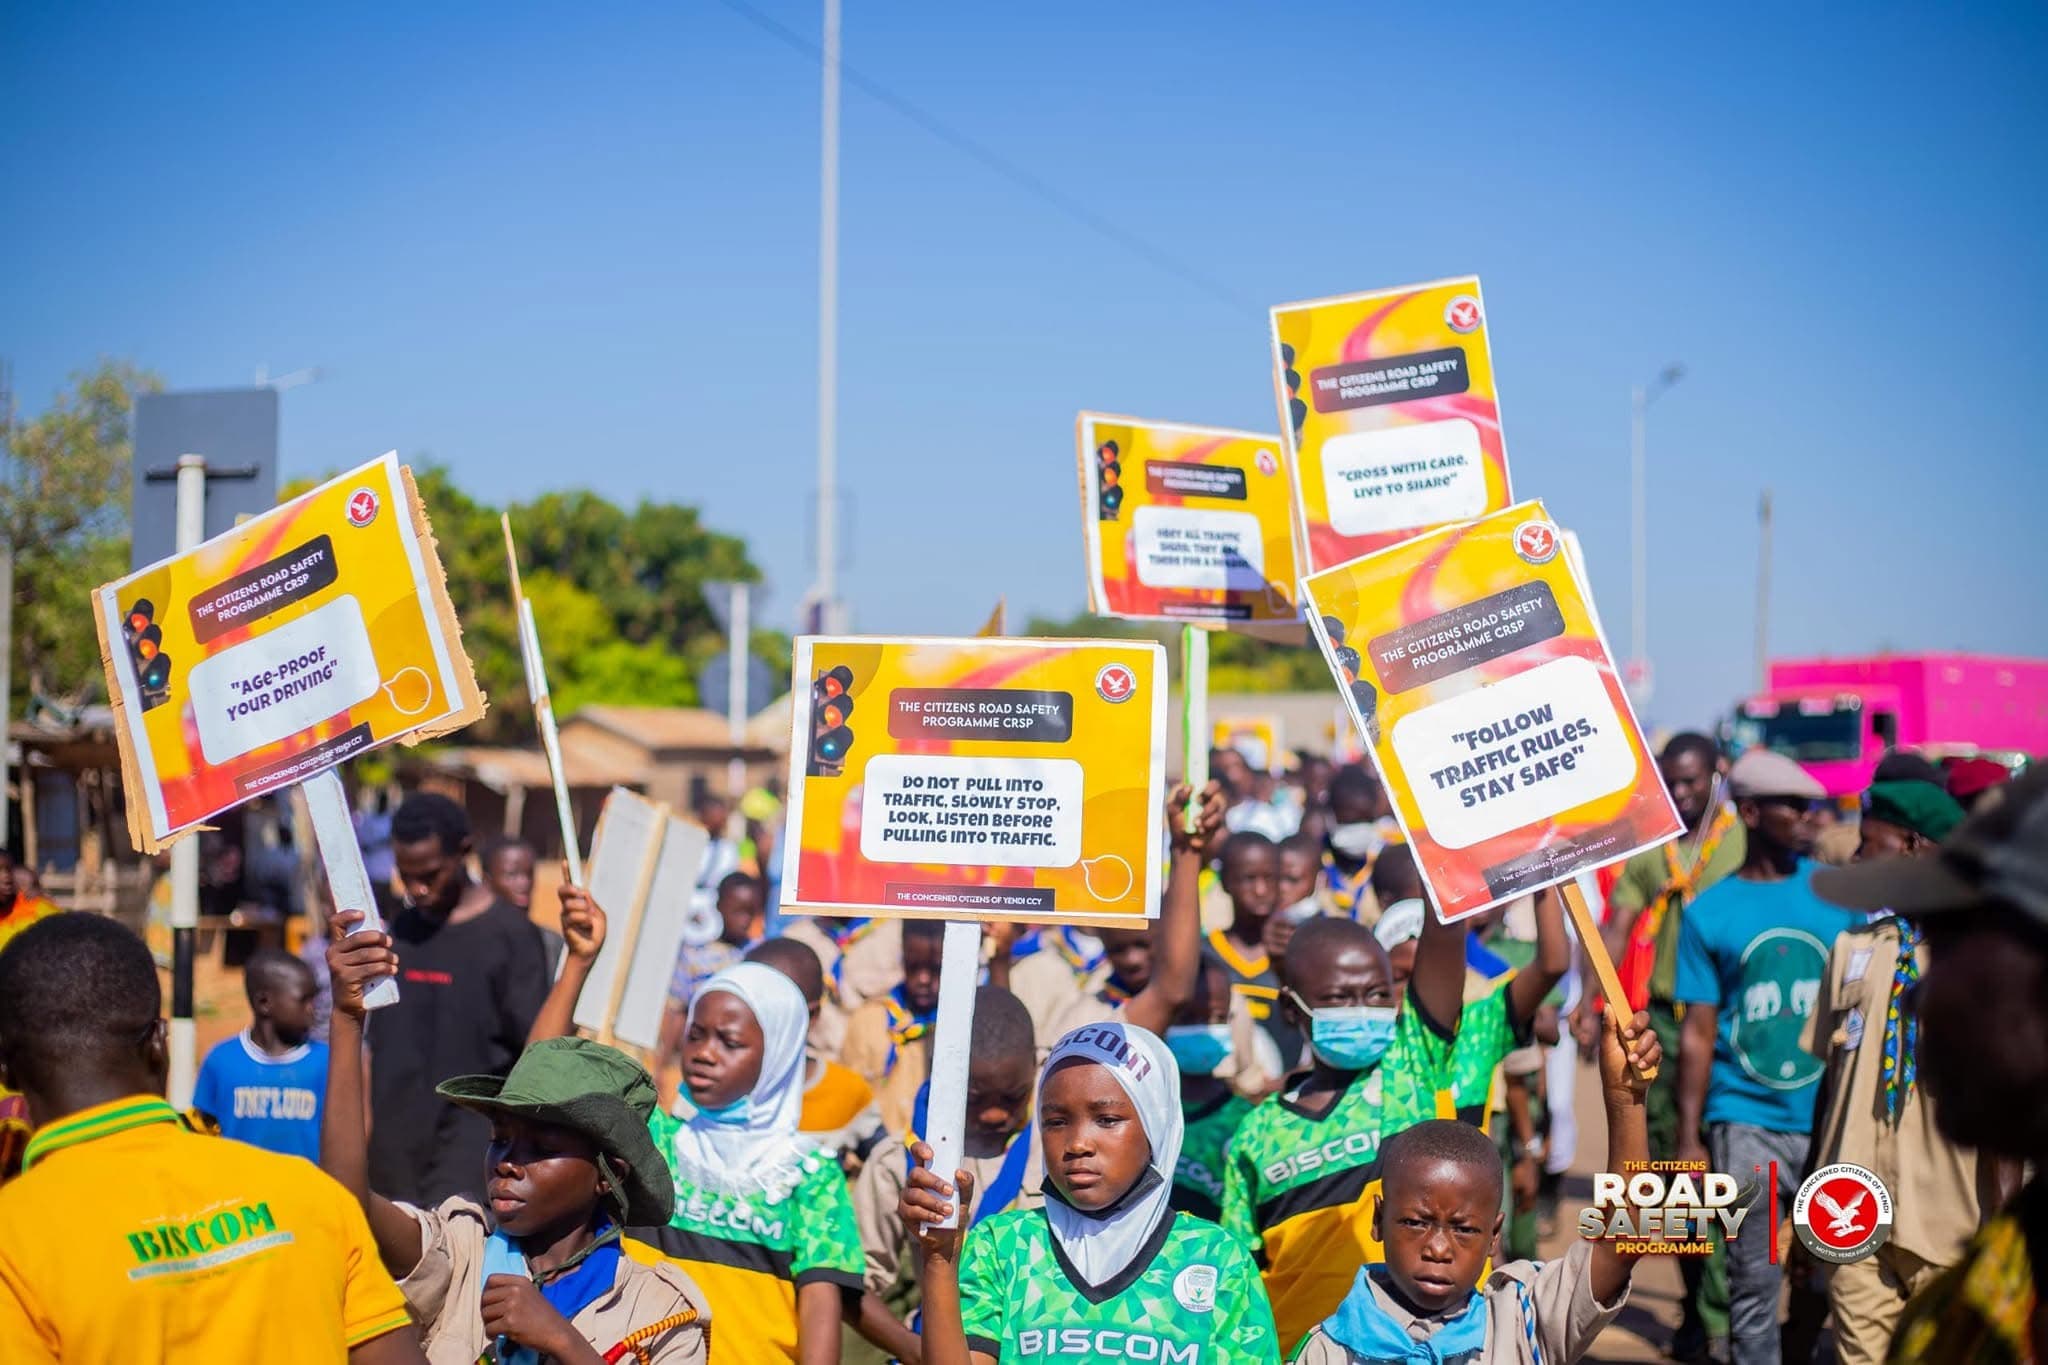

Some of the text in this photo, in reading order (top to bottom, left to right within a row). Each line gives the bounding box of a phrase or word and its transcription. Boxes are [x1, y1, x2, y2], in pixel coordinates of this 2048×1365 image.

[1387, 366, 1417, 380] ROAD
[1419, 359, 1458, 374] SAFETY
[1391, 460, 1426, 475] WITH
[1387, 481, 1403, 494] TO
[196, 550, 324, 618] THE CITIZENS ROAD SAFETY
[217, 573, 310, 622] PROGRAMME CRSP
[1381, 597, 1544, 664] THE CITIZENS ROAD SAFETY
[1411, 620, 1525, 669] PROGRAMME CRSP
[226, 693, 272, 722] YOUR
[899, 701, 1060, 715] THE CITIZENS ROAD SAFETY
[922, 716, 1033, 729] PROGRAMME CRSP
[1451, 703, 1554, 751] "FOLLOW
[244, 779, 258, 790] THE
[257, 765, 299, 785] CONCERNED
[1430, 745, 1520, 789] TRAFFIC
[902, 776, 924, 789] DO
[965, 777, 1002, 791] PULL
[1459, 773, 1515, 808] STAY
[883, 793, 1061, 811] TRAFFIC, SLOWLY STOP,
[888, 810, 933, 826] LOOK,
[990, 831, 1057, 847] TRAFFIC.
[1501, 874, 1514, 882] THE
[1515, 861, 1550, 878] CONCERNED
[1576, 848, 1585, 856] OF
[1585, 842, 1603, 853] YENDI
[897, 892, 1042, 906] THE CONCERNED CITIZENS OF YENDI CCY
[126, 1201, 277, 1263] BISCOM
[1019, 1328, 1200, 1365] BISCOM
